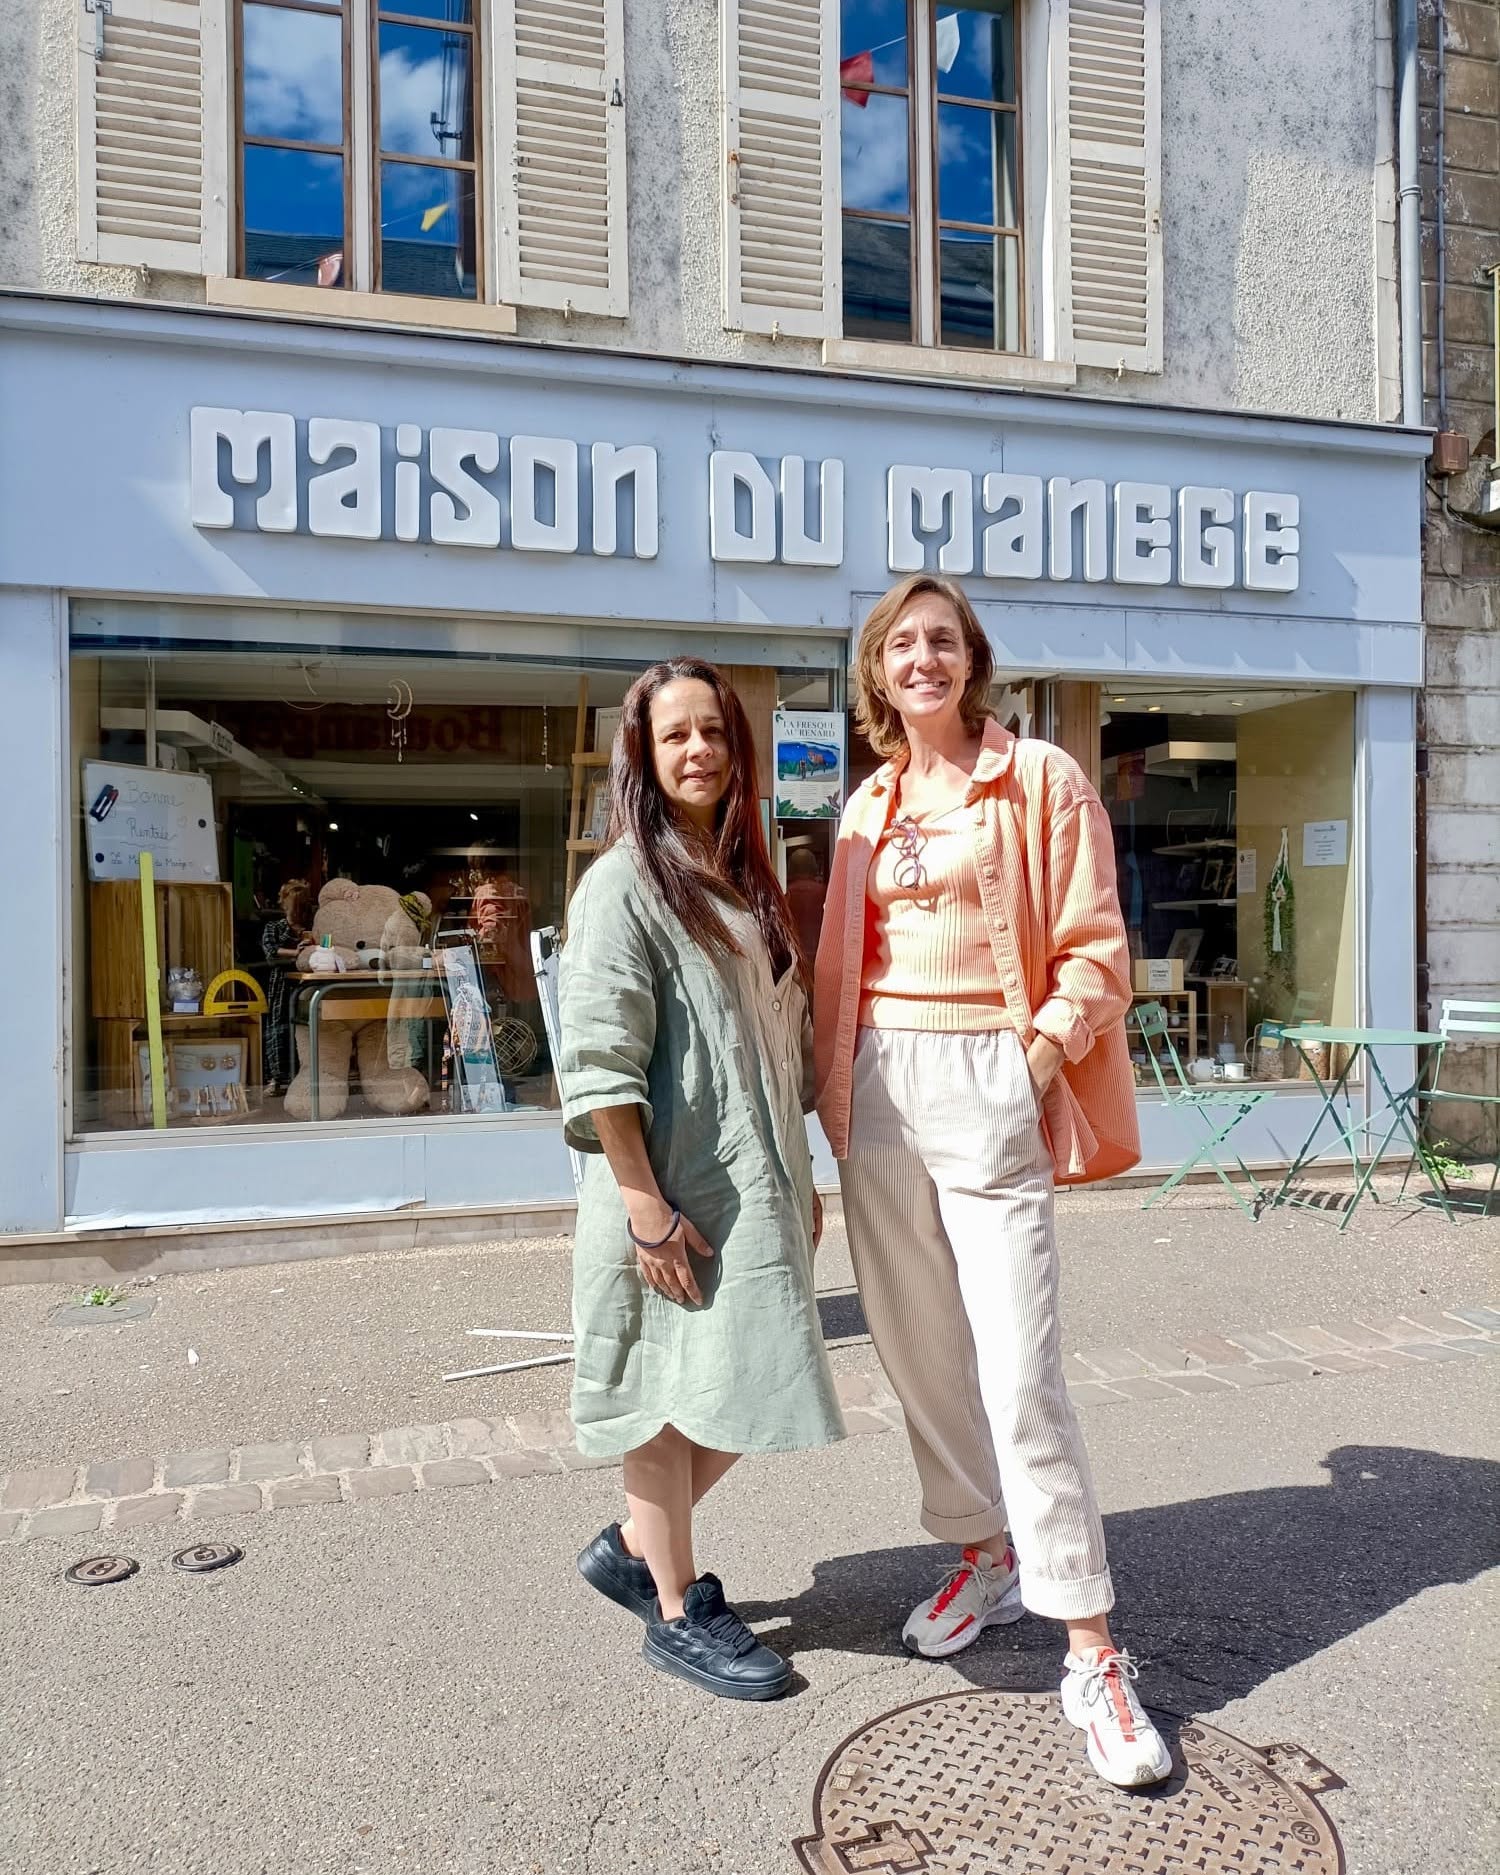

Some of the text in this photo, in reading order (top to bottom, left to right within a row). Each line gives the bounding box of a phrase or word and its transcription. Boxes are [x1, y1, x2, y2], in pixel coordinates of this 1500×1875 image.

[709, 450, 844, 567] DU
[783, 721, 834, 730] LA FRESQUE
[799, 729, 835, 737] RENARD
[1207, 1742, 1235, 1757] EN
[1294, 1823, 1318, 1843] NF
